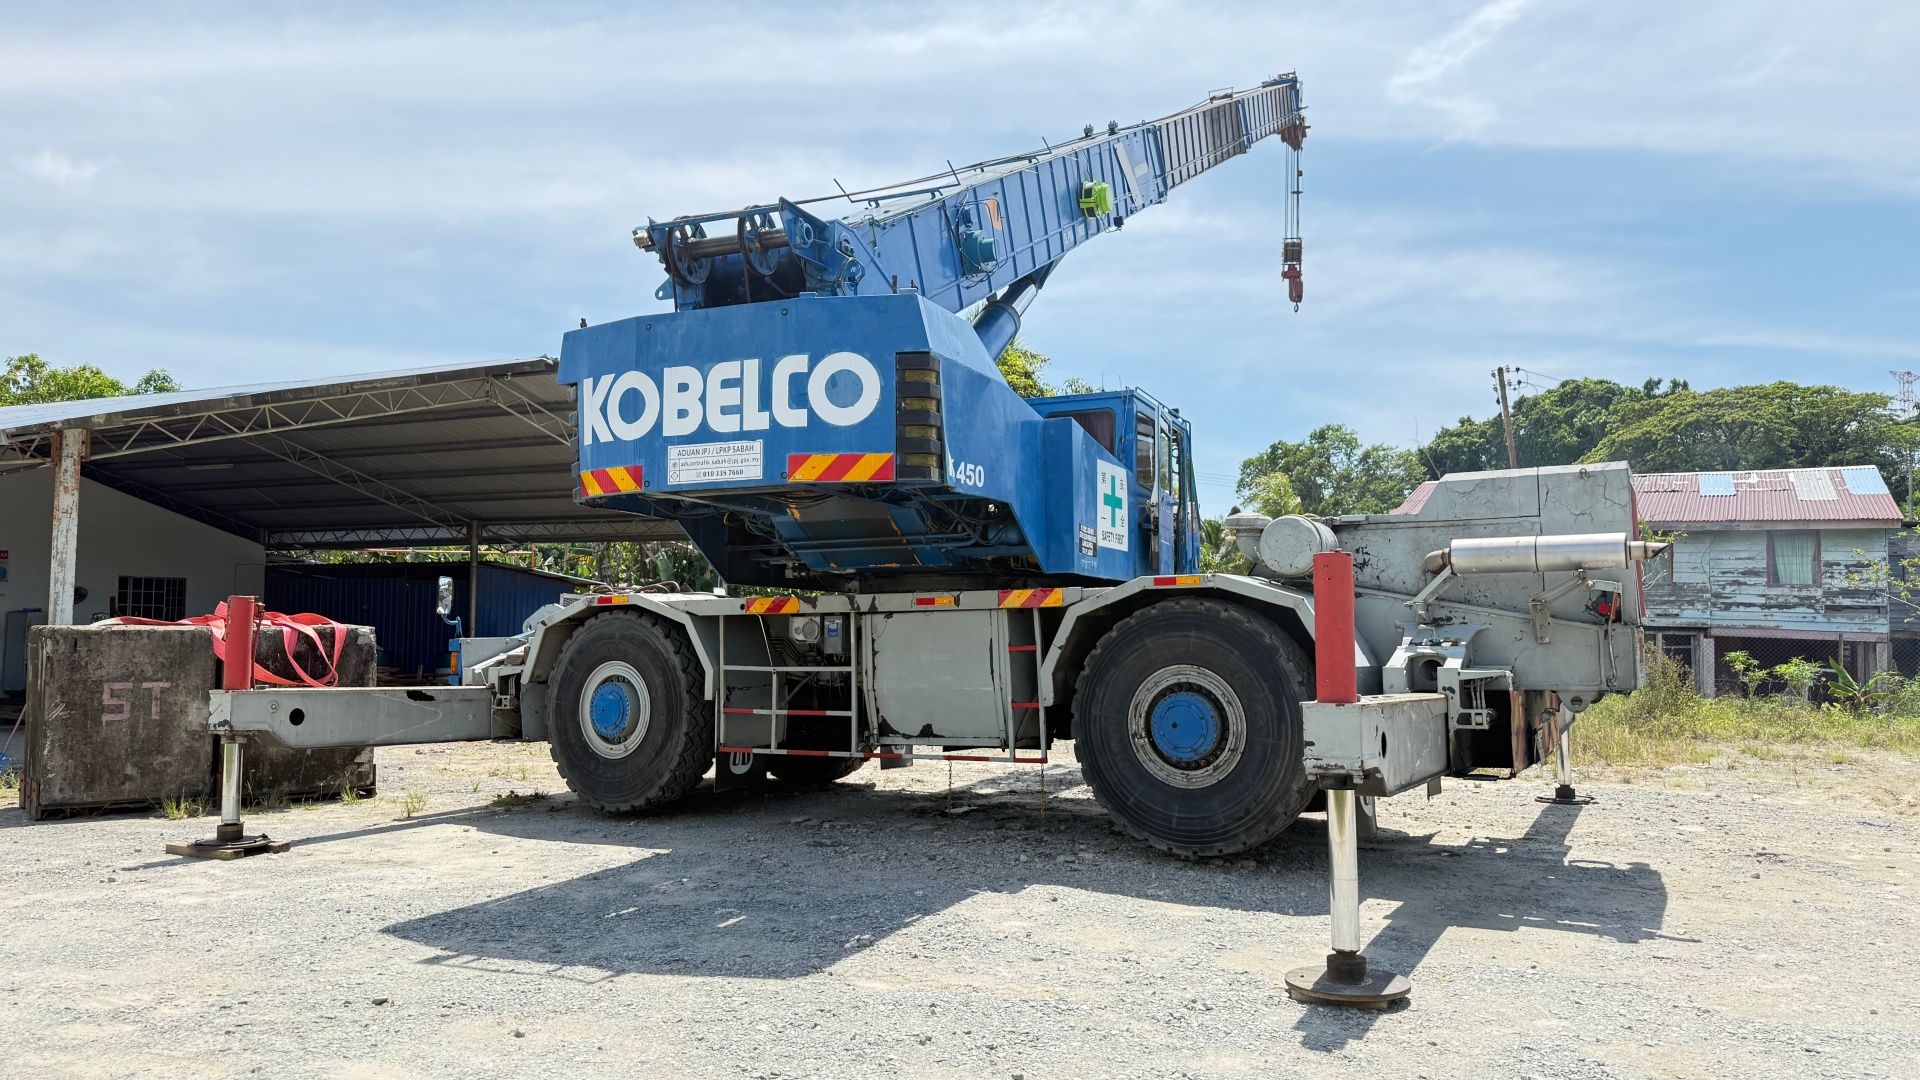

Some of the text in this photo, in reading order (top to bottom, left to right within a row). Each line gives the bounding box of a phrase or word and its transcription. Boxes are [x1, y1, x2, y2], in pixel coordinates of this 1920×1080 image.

[583, 352, 881, 445] KOBELCO
[677, 447, 701, 457] ADUAN
[701, 447, 711, 456] JPJ
[715, 446, 732, 454] LPKP
[732, 444, 754, 453] SABAH
[702, 470, 715, 478] 010
[728, 468, 744, 476] 7660
[1101, 530, 1125, 545] SAFETY FIRST
